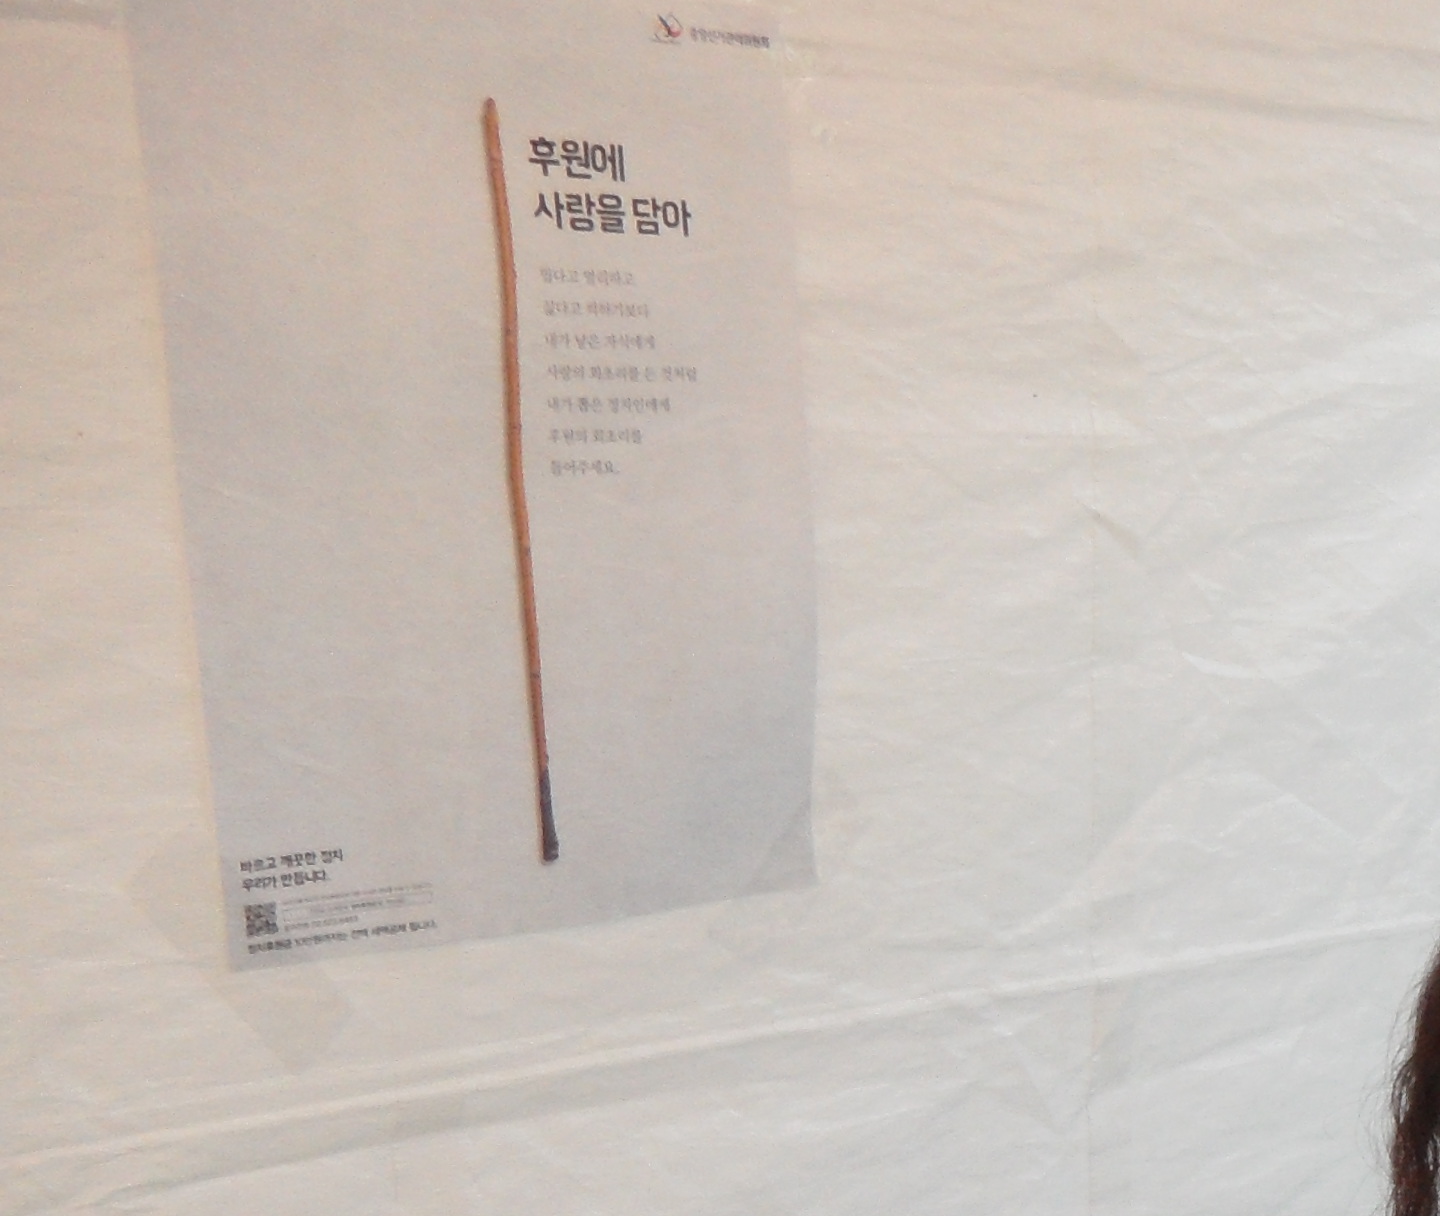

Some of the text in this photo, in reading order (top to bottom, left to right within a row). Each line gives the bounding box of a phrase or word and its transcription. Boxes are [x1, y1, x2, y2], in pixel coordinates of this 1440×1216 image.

[528, 136, 626, 182] 후원에
[533, 191, 692, 238] 사랑을 담아
[240, 856, 277, 873] 바르고
[242, 874, 278, 892] 우리가
